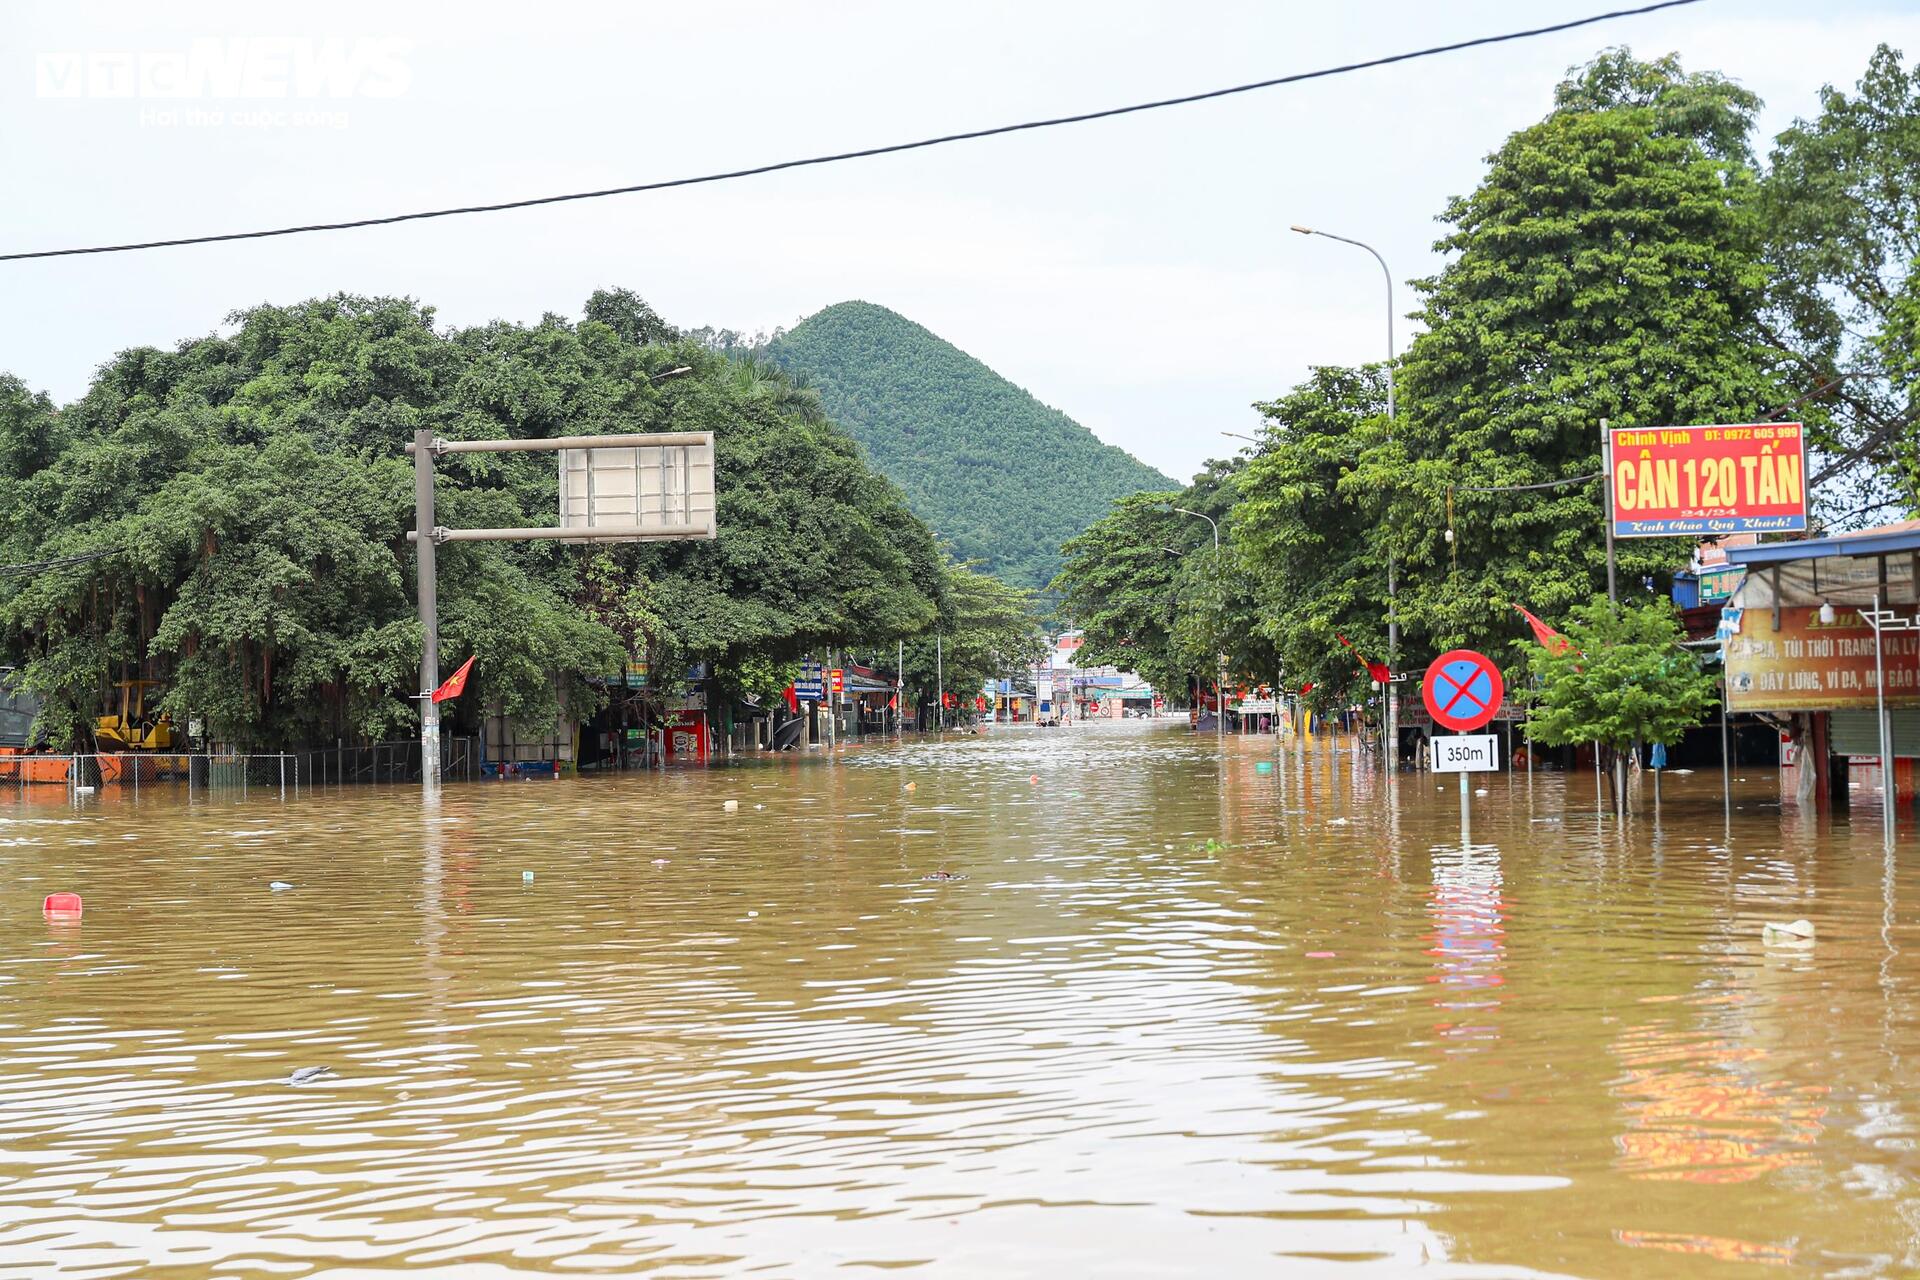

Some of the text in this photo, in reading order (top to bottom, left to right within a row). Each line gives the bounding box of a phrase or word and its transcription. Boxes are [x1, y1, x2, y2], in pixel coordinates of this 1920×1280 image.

[1661, 431, 1691, 447] Vịnh
[1724, 429, 1751, 440] 0972
[1754, 428, 1774, 438] 605
[1777, 427, 1798, 437] 999
[1617, 440, 1800, 510] CÂN 120 TẤN
[1681, 508, 1738, 517] 24/24
[1841, 670, 1862, 691] DA,
[1889, 664, 1913, 687] BẢO
[1447, 746, 1483, 762] 350m
